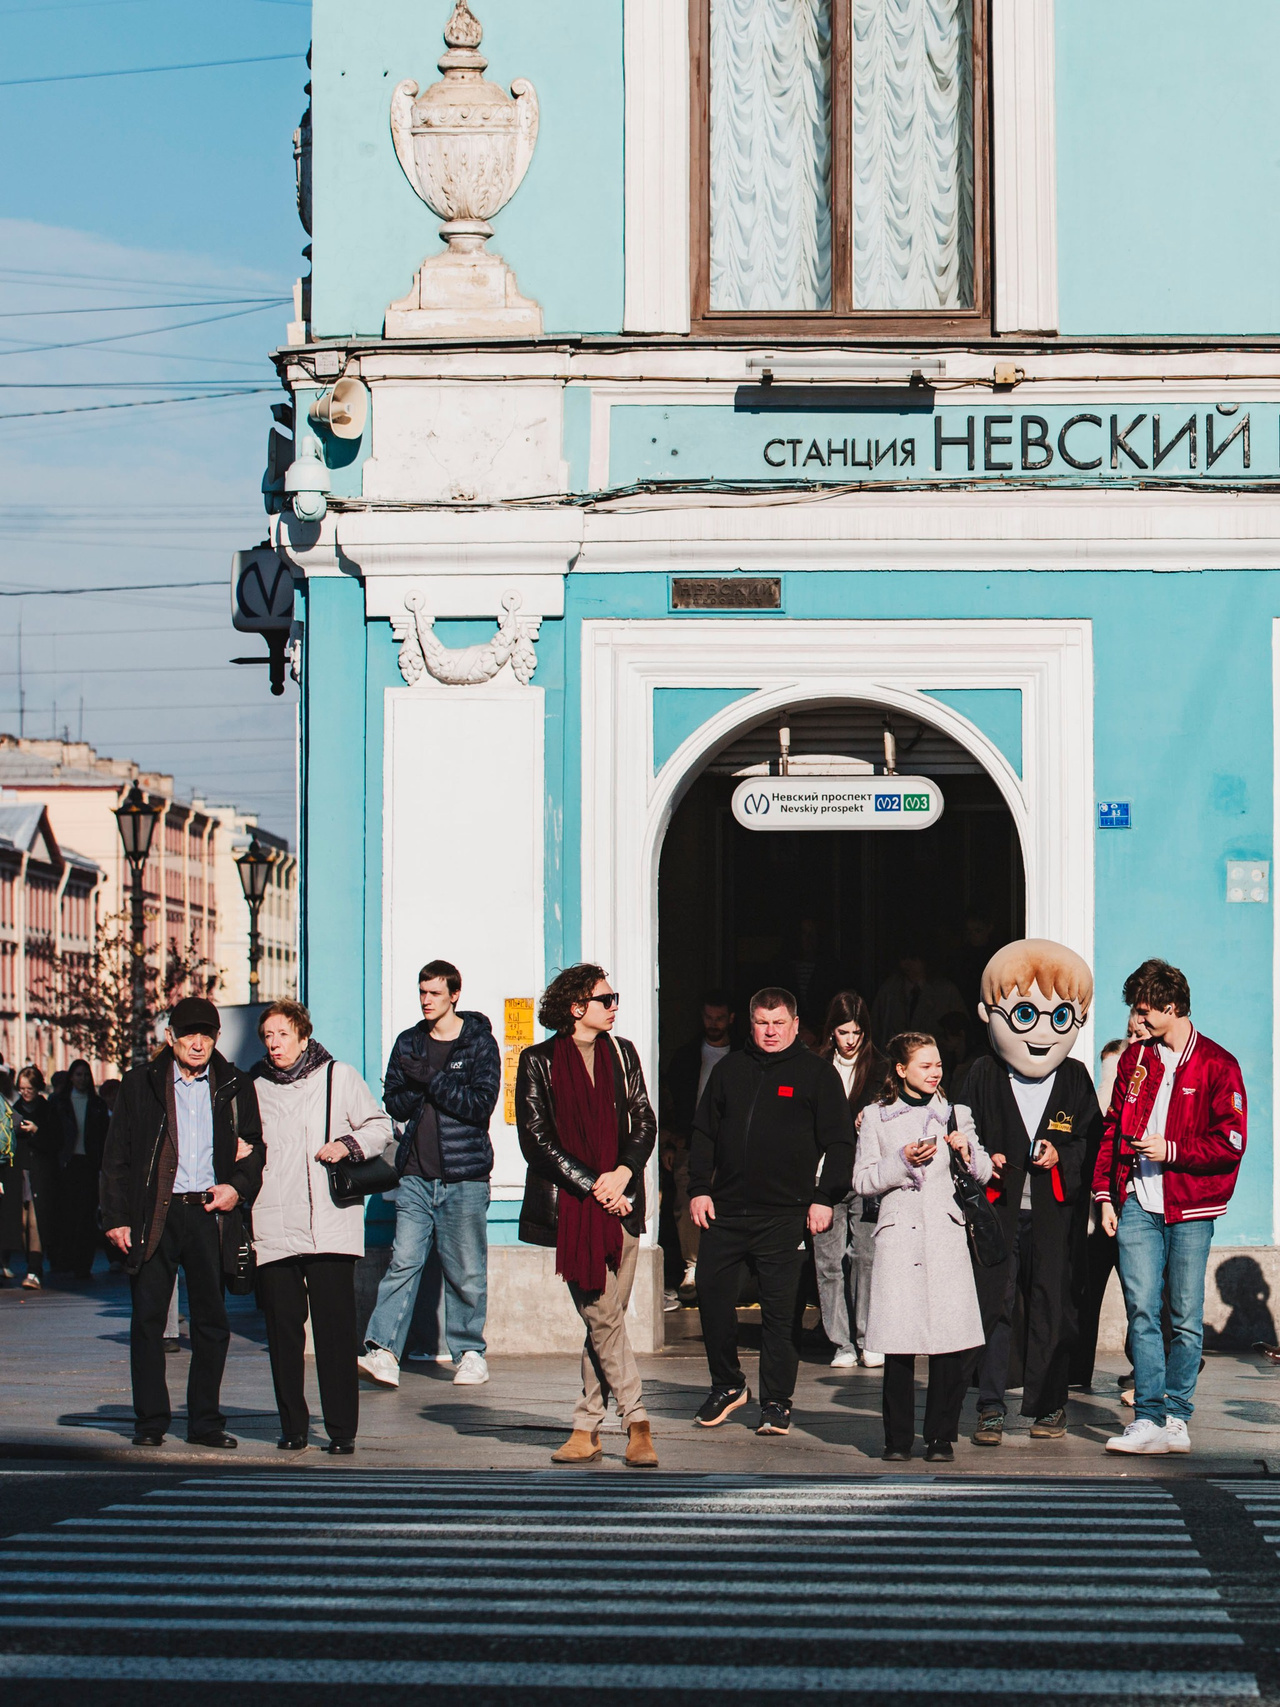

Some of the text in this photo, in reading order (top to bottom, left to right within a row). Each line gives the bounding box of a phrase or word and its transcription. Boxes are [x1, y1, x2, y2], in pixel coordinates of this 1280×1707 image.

[763, 437, 916, 470] СТАНЦИЯ
[934, 403, 1251, 471] НЕВСКИЙ
[680, 583, 773, 596] НЕВСКИЙ
[772, 792, 872, 803] Невский проспект
[781, 805, 864, 815] Nevskiy prospekt
